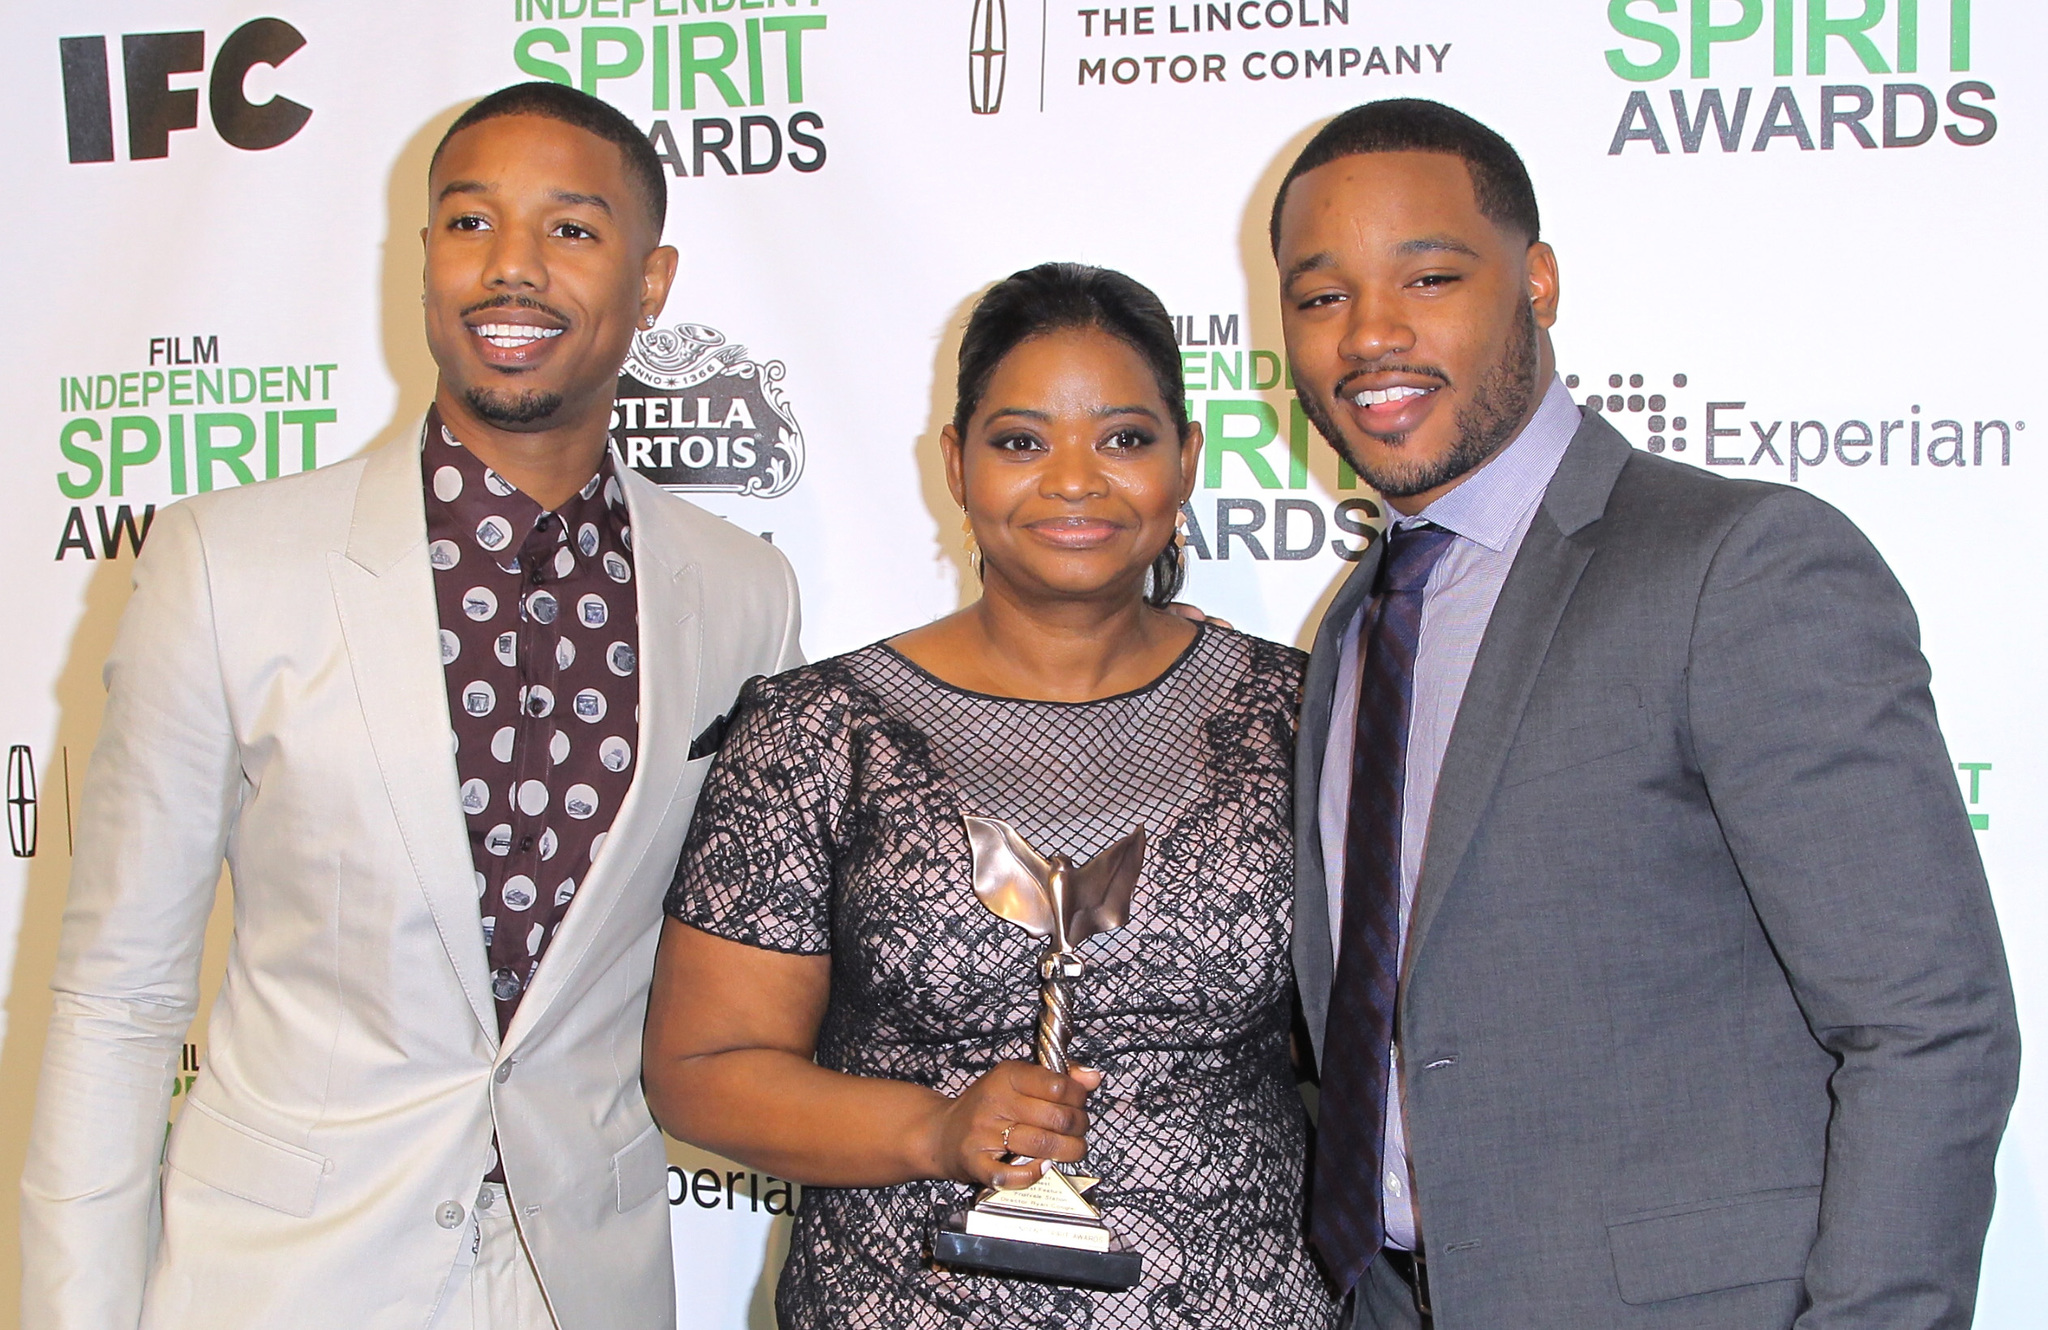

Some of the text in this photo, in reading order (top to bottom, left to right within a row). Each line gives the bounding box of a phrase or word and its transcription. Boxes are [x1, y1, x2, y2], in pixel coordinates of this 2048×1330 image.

[1077, 0, 1349, 37] THE LINCOLN
[513, 15, 827, 111] SPIRIT
[1078, 43, 1452, 85] MOTOR COMPANY
[59, 17, 313, 163] IFC
[1607, 80, 1998, 155] AWARDS
[648, 111, 827, 177] ARDS
[150, 335, 219, 366] FILM
[1168, 314, 1239, 346] ILM
[60, 364, 338, 412] INDEPENDENT
[629, 363, 716, 386] ANNO 1366
[57, 408, 338, 500] SPIRIT
[611, 436, 757, 469] RTOIS
